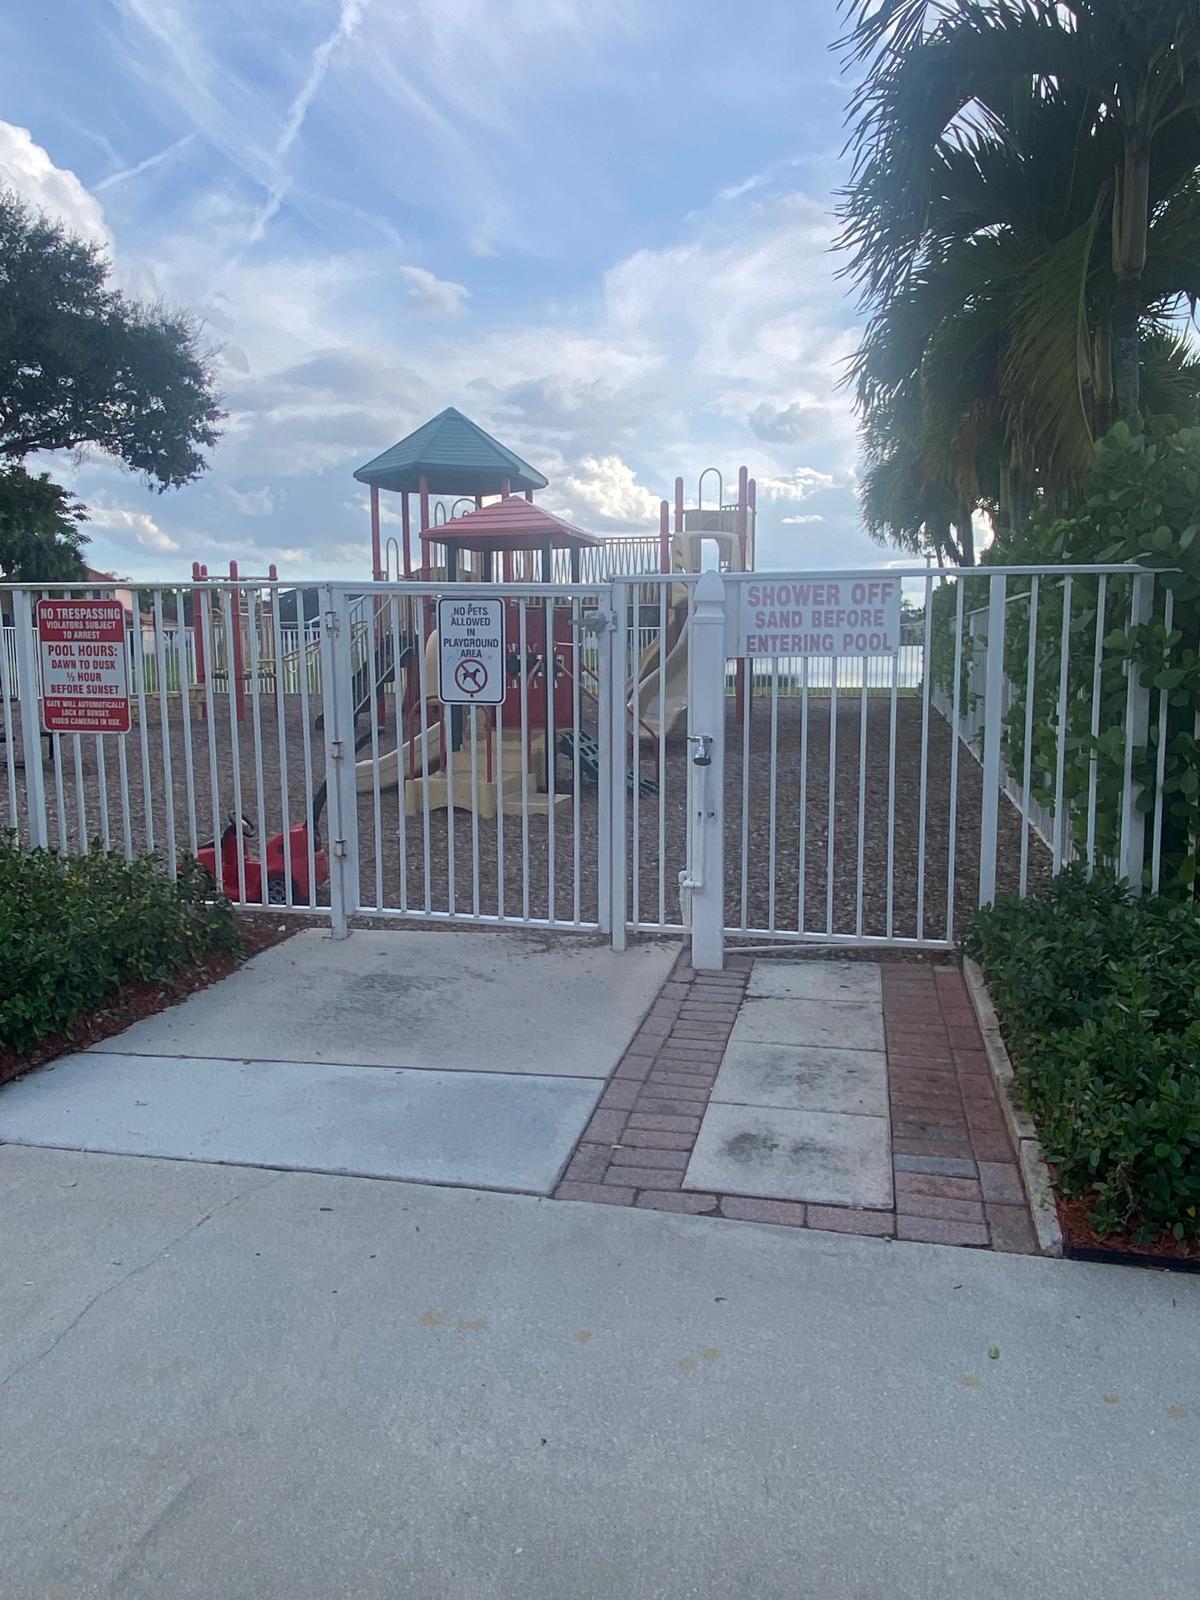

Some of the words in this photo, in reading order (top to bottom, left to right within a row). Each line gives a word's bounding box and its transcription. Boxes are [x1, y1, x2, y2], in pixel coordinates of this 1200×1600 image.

[747, 584, 840, 607] SHOWER
[851, 582, 894, 606] OFF
[40, 608, 54, 620] NO
[58, 608, 121, 620] TRESPASSING
[454, 606, 466, 616] NO
[468, 606, 488, 616] PETS
[450, 618, 490, 626] ALLOWED
[754, 610, 803, 629] SAND
[812, 608, 885, 628] BEFORE
[46, 621, 84, 630] VIOLATORS
[85, 621, 116, 630] SUBJECT
[63, 631, 72, 639] TO
[74, 631, 100, 640] ARREST
[466, 628, 476, 636] IN
[444, 638, 499, 648] PLAYGROUND
[746, 634, 834, 652] ENTERING
[842, 632, 892, 652] POOL
[48, 644, 75, 656] POOL
[78, 645, 118, 657] HOURS:
[460, 649, 482, 658] AREA
[52, 660, 76, 669] DAWN
[80, 660, 90, 670] TO
[93, 660, 116, 670] DUSK
[78, 672, 102, 682] HOUR
[51, 684, 84, 694] BEFORE
[86, 685, 119, 695] SUNSET
[78, 700, 125, 708] AUTOMATICALLY
